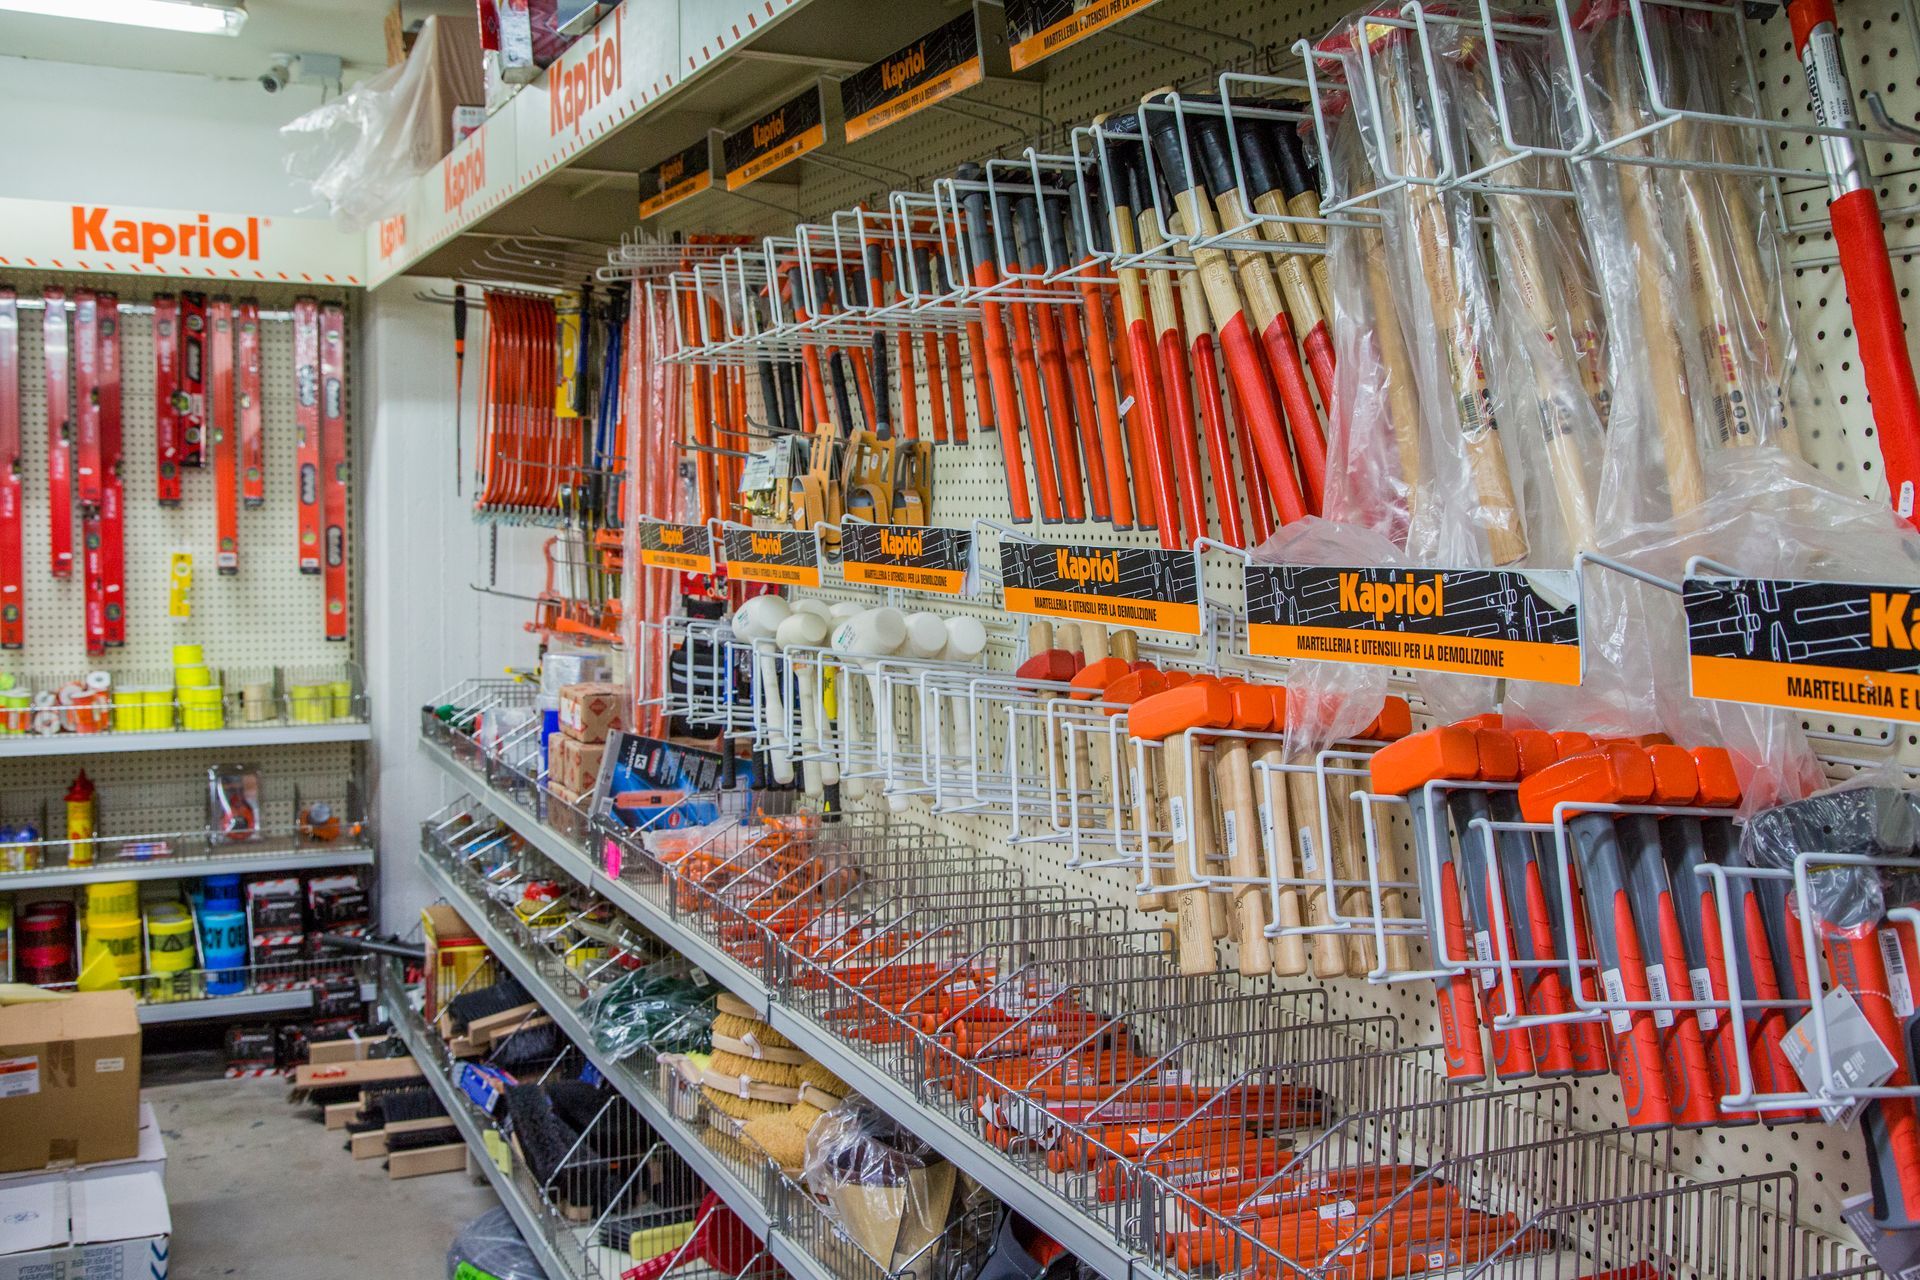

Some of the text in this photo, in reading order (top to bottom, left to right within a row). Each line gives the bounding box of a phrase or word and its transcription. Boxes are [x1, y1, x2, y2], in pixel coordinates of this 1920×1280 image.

[549, 4, 622, 137] Kapriol
[881, 40, 926, 91] Kapriol
[753, 108, 785, 149] Kapriol
[444, 124, 486, 216] Kapriol
[71, 206, 260, 265] Kapriol
[660, 525, 684, 548] Kapriol
[751, 533, 782, 559] Kapriol
[880, 529, 923, 560] Kapriol
[1056, 548, 1120, 587] Kapriol
[1034, 597, 1157, 622] MARTELLERIA E UTENSILI PER LA DEMOLIZIONE
[1339, 572, 1444, 622] Kapriol
[1297, 635, 1504, 668] MARTELLERIA E UTENSILI PER LA DEMOLIZIONE
[1787, 676, 1909, 709] MARTELLERIA E
